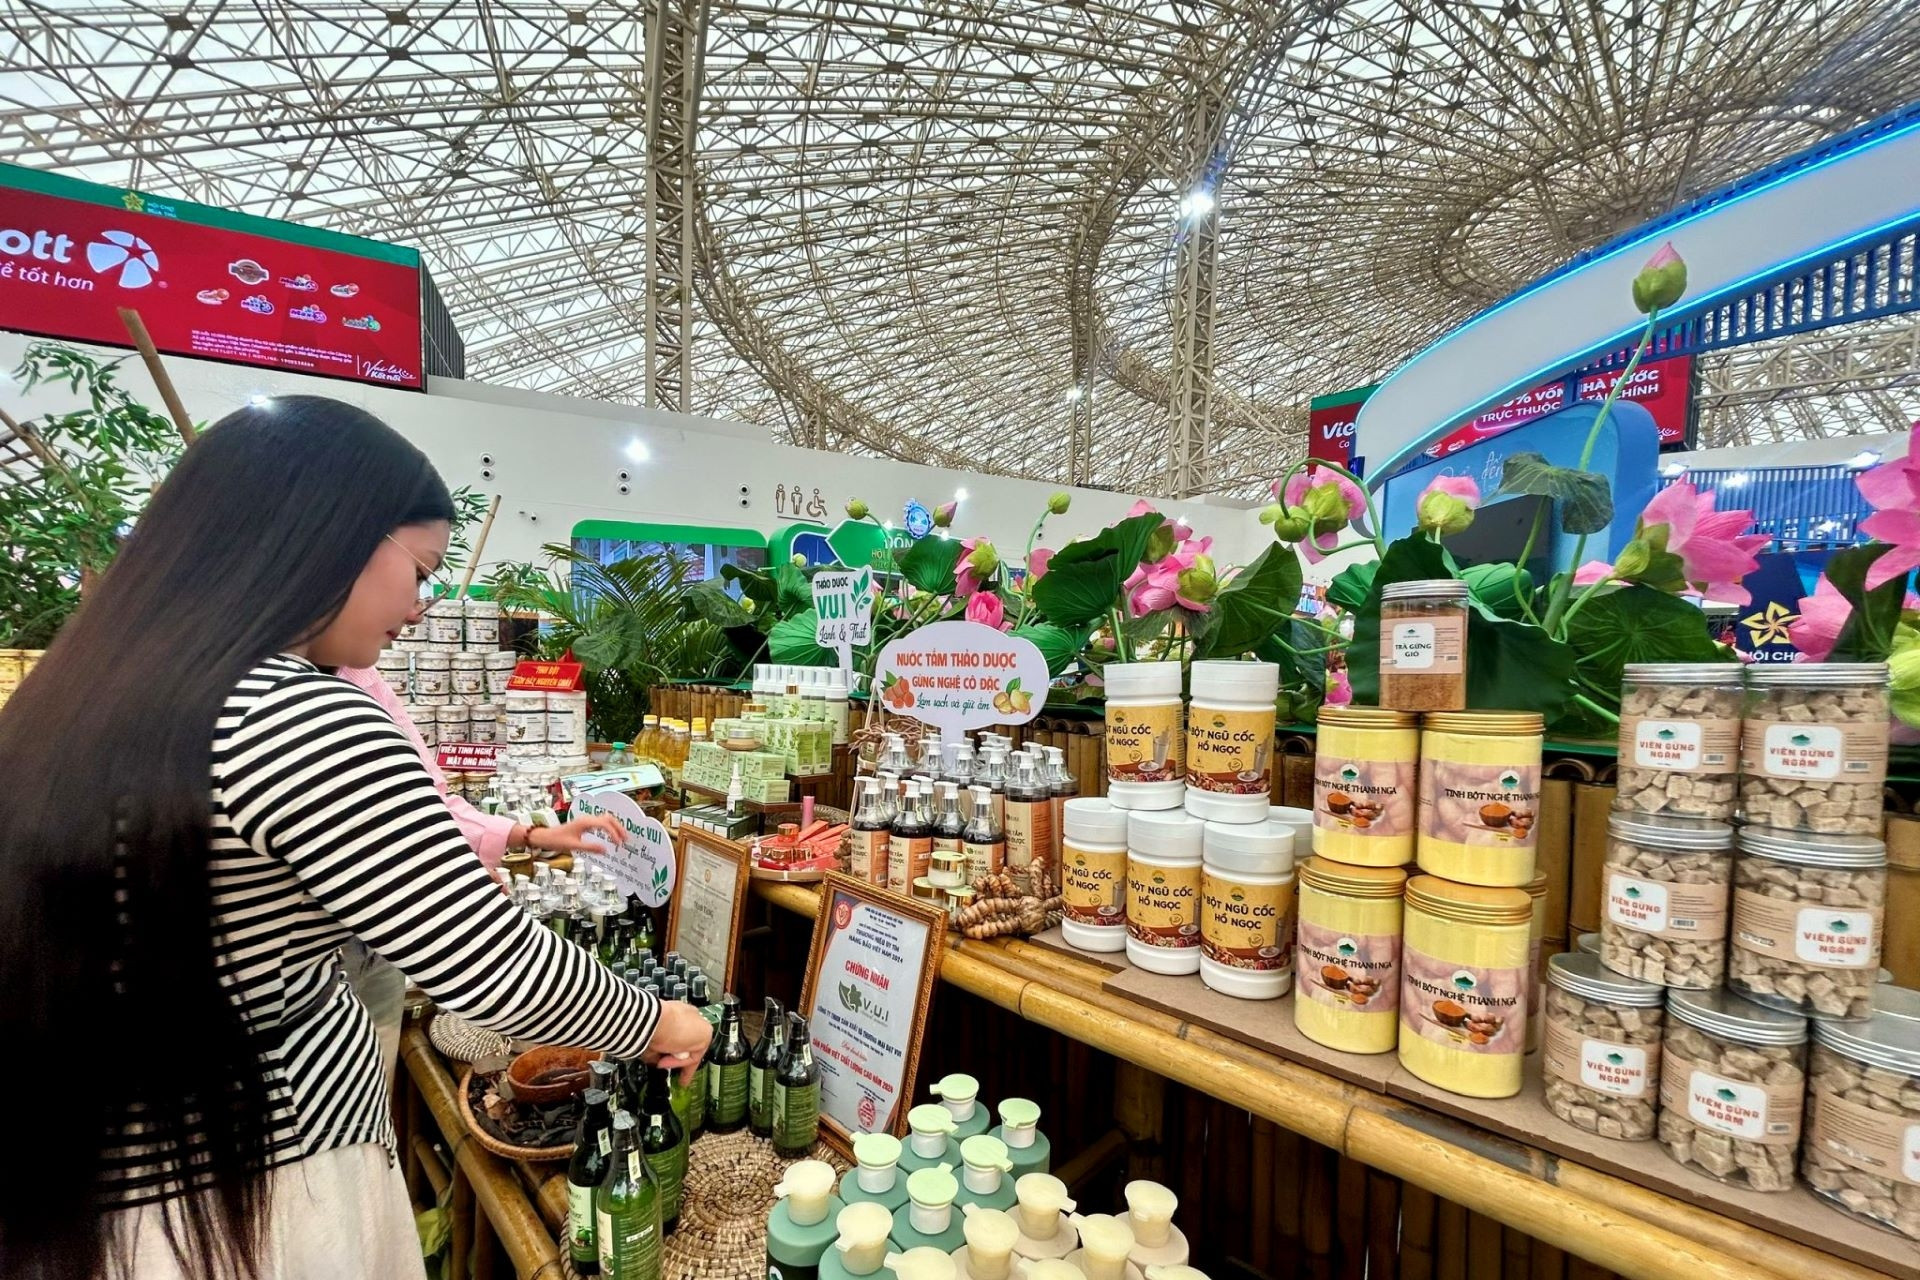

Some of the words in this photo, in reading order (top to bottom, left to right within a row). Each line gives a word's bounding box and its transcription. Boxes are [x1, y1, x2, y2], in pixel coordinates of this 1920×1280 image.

[19, 266, 50, 284] tốt
[54, 271, 94, 291] hơn
[1517, 401, 1561, 417] THUỘC
[816, 593, 847, 620] V.U.I
[839, 623, 847, 642] &
[937, 675, 960, 692] NGHỆ
[963, 675, 977, 690] CÔ
[1113, 725, 1128, 735] NGŨ
[1131, 723, 1151, 735] CỐC
[1207, 730, 1229, 741] NGŨ
[1233, 730, 1255, 742] CỐC
[1116, 738, 1139, 748] NGỌC
[1212, 744, 1241, 756] NGỌC
[1331, 783, 1351, 794] NGHỆ
[1351, 785, 1380, 795] THANH
[1381, 786, 1397, 795] NGA
[1445, 788, 1466, 799] TINH
[1467, 791, 1485, 800] BỘT
[1486, 792, 1511, 802] NGHỆ
[1072, 867, 1089, 877] NGŨ
[1092, 869, 1112, 880] CỐC
[1076, 880, 1100, 892] NGỌC
[1148, 886, 1169, 897] NGŨ
[1173, 885, 1193, 897] CỐC
[1153, 900, 1181, 911] NGỌC
[1206, 895, 1222, 909] BỘT
[1225, 903, 1249, 915] NGŨ
[1253, 903, 1276, 917] CỐC
[1231, 917, 1262, 931] NGỌC
[1312, 950, 1326, 961] BỘT
[1326, 956, 1348, 969] NGHỆ
[1348, 960, 1378, 970] THANH
[1378, 960, 1393, 969] NGA
[845, 959, 870, 981] CHỨNG
[869, 970, 890, 992] NHẬN
[1422, 981, 1439, 995] BỘT
[1440, 988, 1466, 1004] NGHỆ
[1466, 994, 1501, 1006] THANH
[1501, 996, 1518, 1006] NGA
[863, 997, 889, 1022] V.U.I
